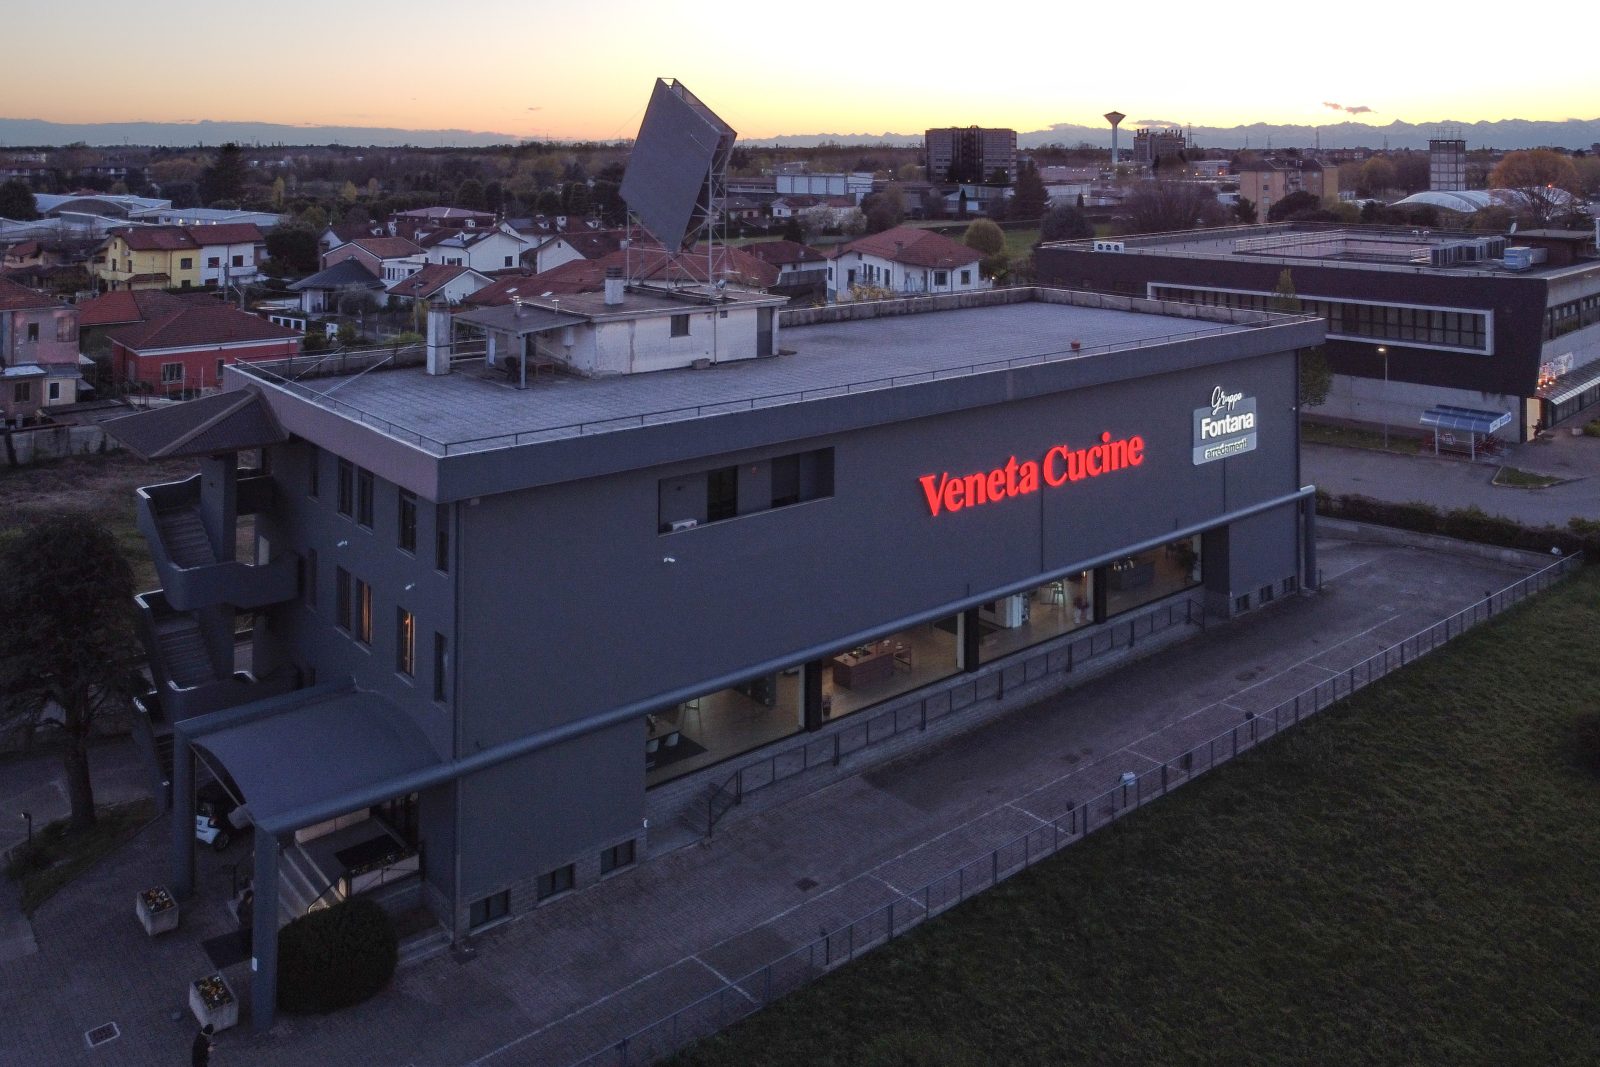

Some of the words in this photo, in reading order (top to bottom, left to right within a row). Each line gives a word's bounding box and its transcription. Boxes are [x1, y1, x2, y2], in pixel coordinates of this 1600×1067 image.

[1211, 386, 1242, 415] Gruppo
[1201, 412, 1254, 440] Fontana
[1205, 438, 1247, 459] arredamenti
[919, 455, 1039, 517] Veneta
[1043, 431, 1144, 487] Cucine
